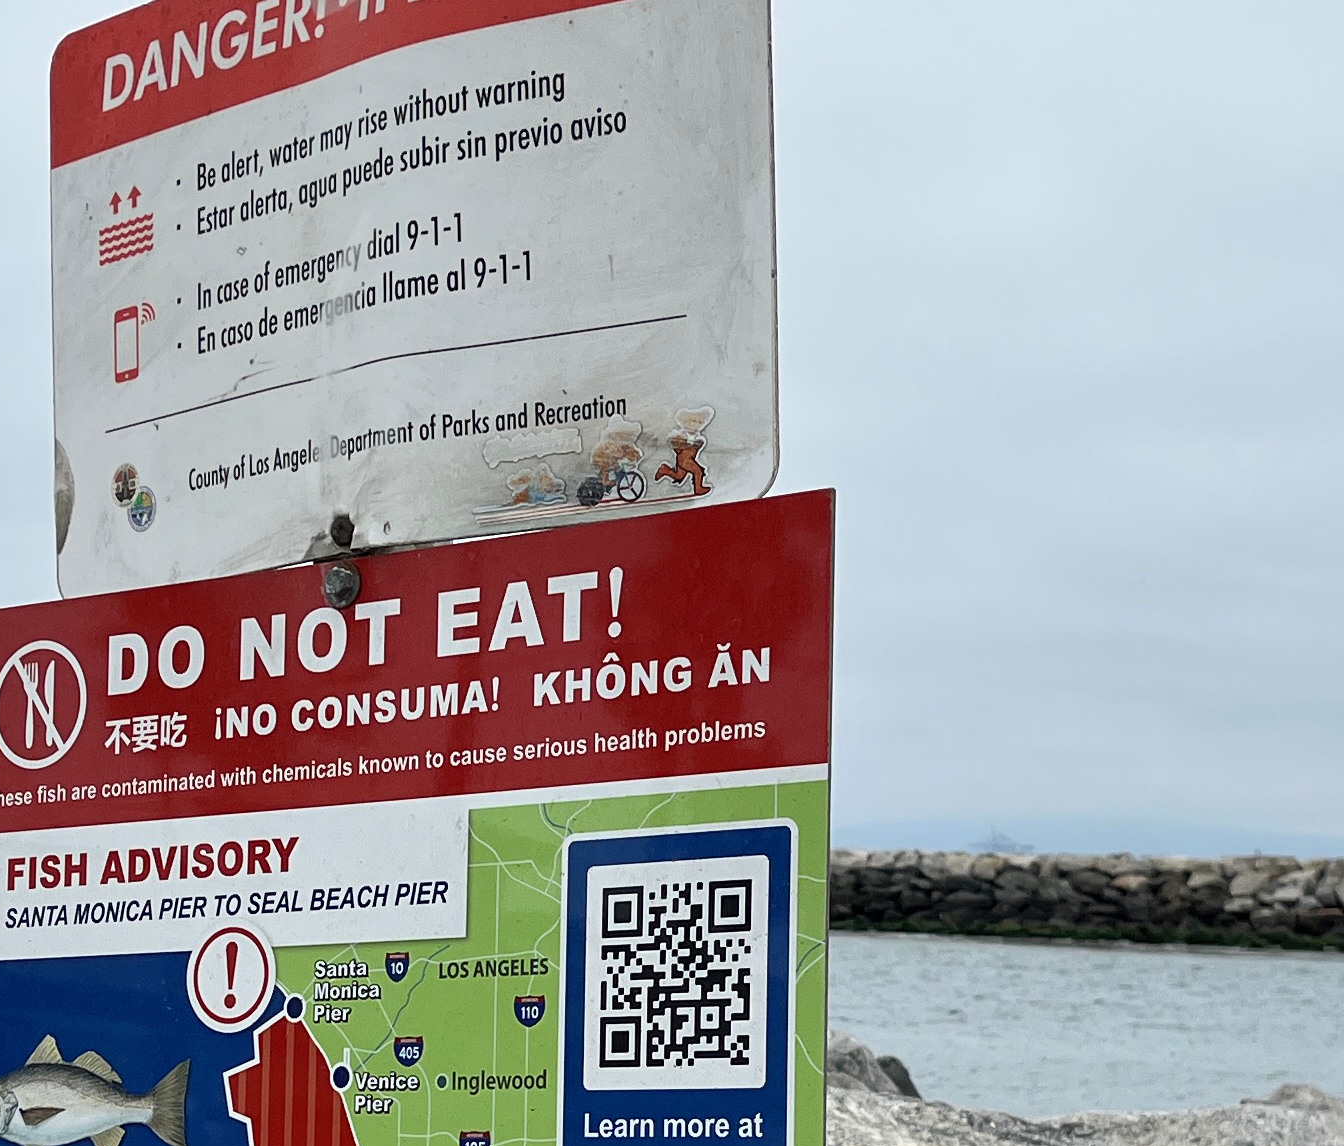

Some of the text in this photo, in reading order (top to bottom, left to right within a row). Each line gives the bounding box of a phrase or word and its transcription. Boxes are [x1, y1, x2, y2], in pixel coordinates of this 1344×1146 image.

[197, 72, 565, 190] Be alert, water may rise without warning
[197, 107, 627, 235] Estar alerta, agua puede subir sin previo aviso
[198, 212, 462, 310] In case of emergency dial 9-1-1
[198, 251, 531, 354] En caso de emergencia llame al 9-1-1
[188, 395, 627, 491] County of Los Angele Department of Parks and Recreation
[107, 566, 625, 696] DO NOT EAT!
[104, 711, 188, 755] 不要吃
[291, 675, 501, 733] CONSUMA!
[533, 652, 692, 707] KHÔNG
[707, 643, 770, 688] ĂN
[37, 784, 66, 804] fish
[71, 783, 96, 801] are
[101, 771, 215, 798] contaminated
[220, 767, 256, 787] with
[262, 757, 353, 783] chemicals
[359, 753, 419, 775] known
[425, 751, 444, 769] to
[450, 746, 507, 767] cause
[513, 736, 587, 761] serious
[594, 728, 657, 753] health
[665, 720, 766, 751] problems
[6, 836, 299, 891] FISH ADVISORY
[5, 881, 449, 929] SANTA MONICA PIER TO SEAL BEACH PIER
[314, 960, 368, 978] Santa
[391, 962, 403, 974] 10
[438, 958, 549, 978] LOS ANGELES
[314, 982, 381, 999] Monica
[313, 1004, 351, 1024] Pier
[521, 1006, 538, 1019] 110
[399, 1047, 419, 1059] 405
[355, 1072, 420, 1091] Venice
[452, 1069, 547, 1095] Inglewood
[354, 1096, 392, 1114] Pier
[584, 1112, 763, 1138] Learn more at
